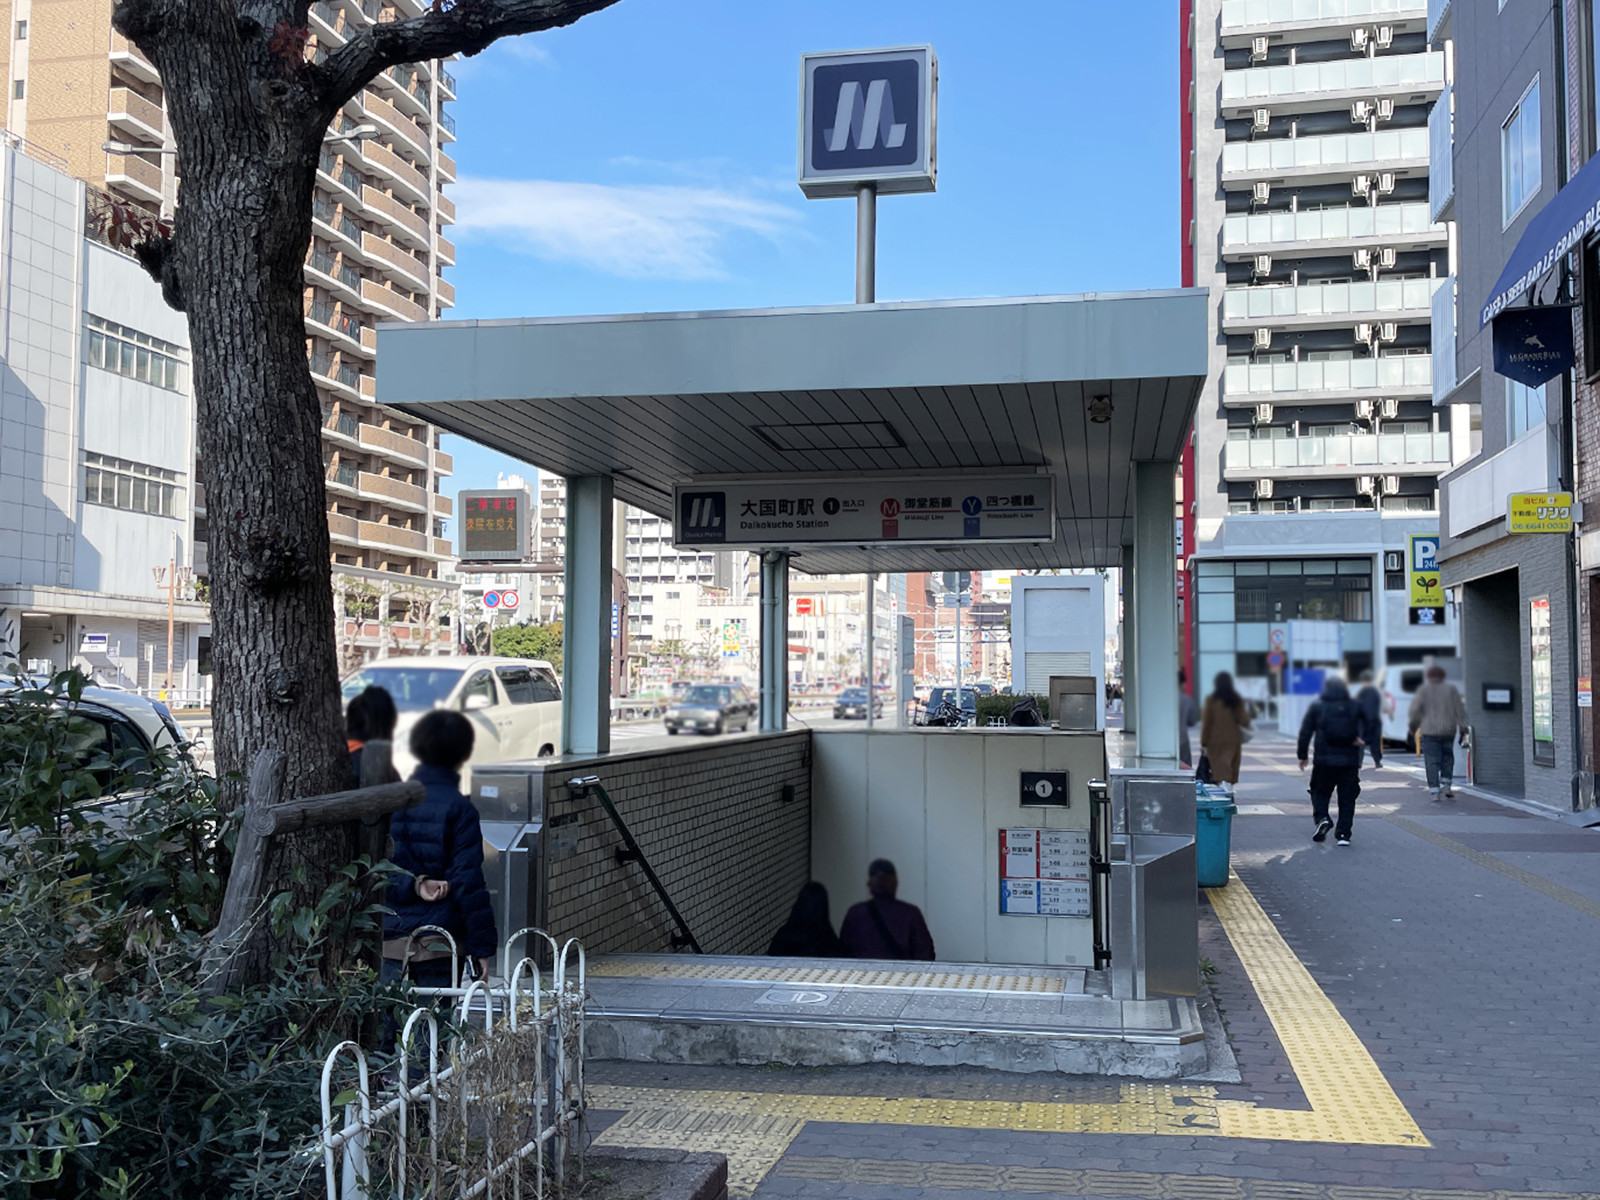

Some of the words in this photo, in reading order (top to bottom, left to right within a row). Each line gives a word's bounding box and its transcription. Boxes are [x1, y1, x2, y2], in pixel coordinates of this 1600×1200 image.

[1526, 260, 1542, 289] BAR
[1542, 248, 1554, 274] LE
[1555, 220, 1584, 262] GRAND
[740, 498, 814, 516] 大国町駅
[883, 502, 897, 514] M
[904, 497, 952, 508] 御堂筋線
[986, 495, 1035, 507] 四つ橋線
[740, 520, 793, 529] Daikokucho
[796, 520, 829, 528] Station
[1416, 541, 1436, 568] P
[506, 595, 515, 604] 50
